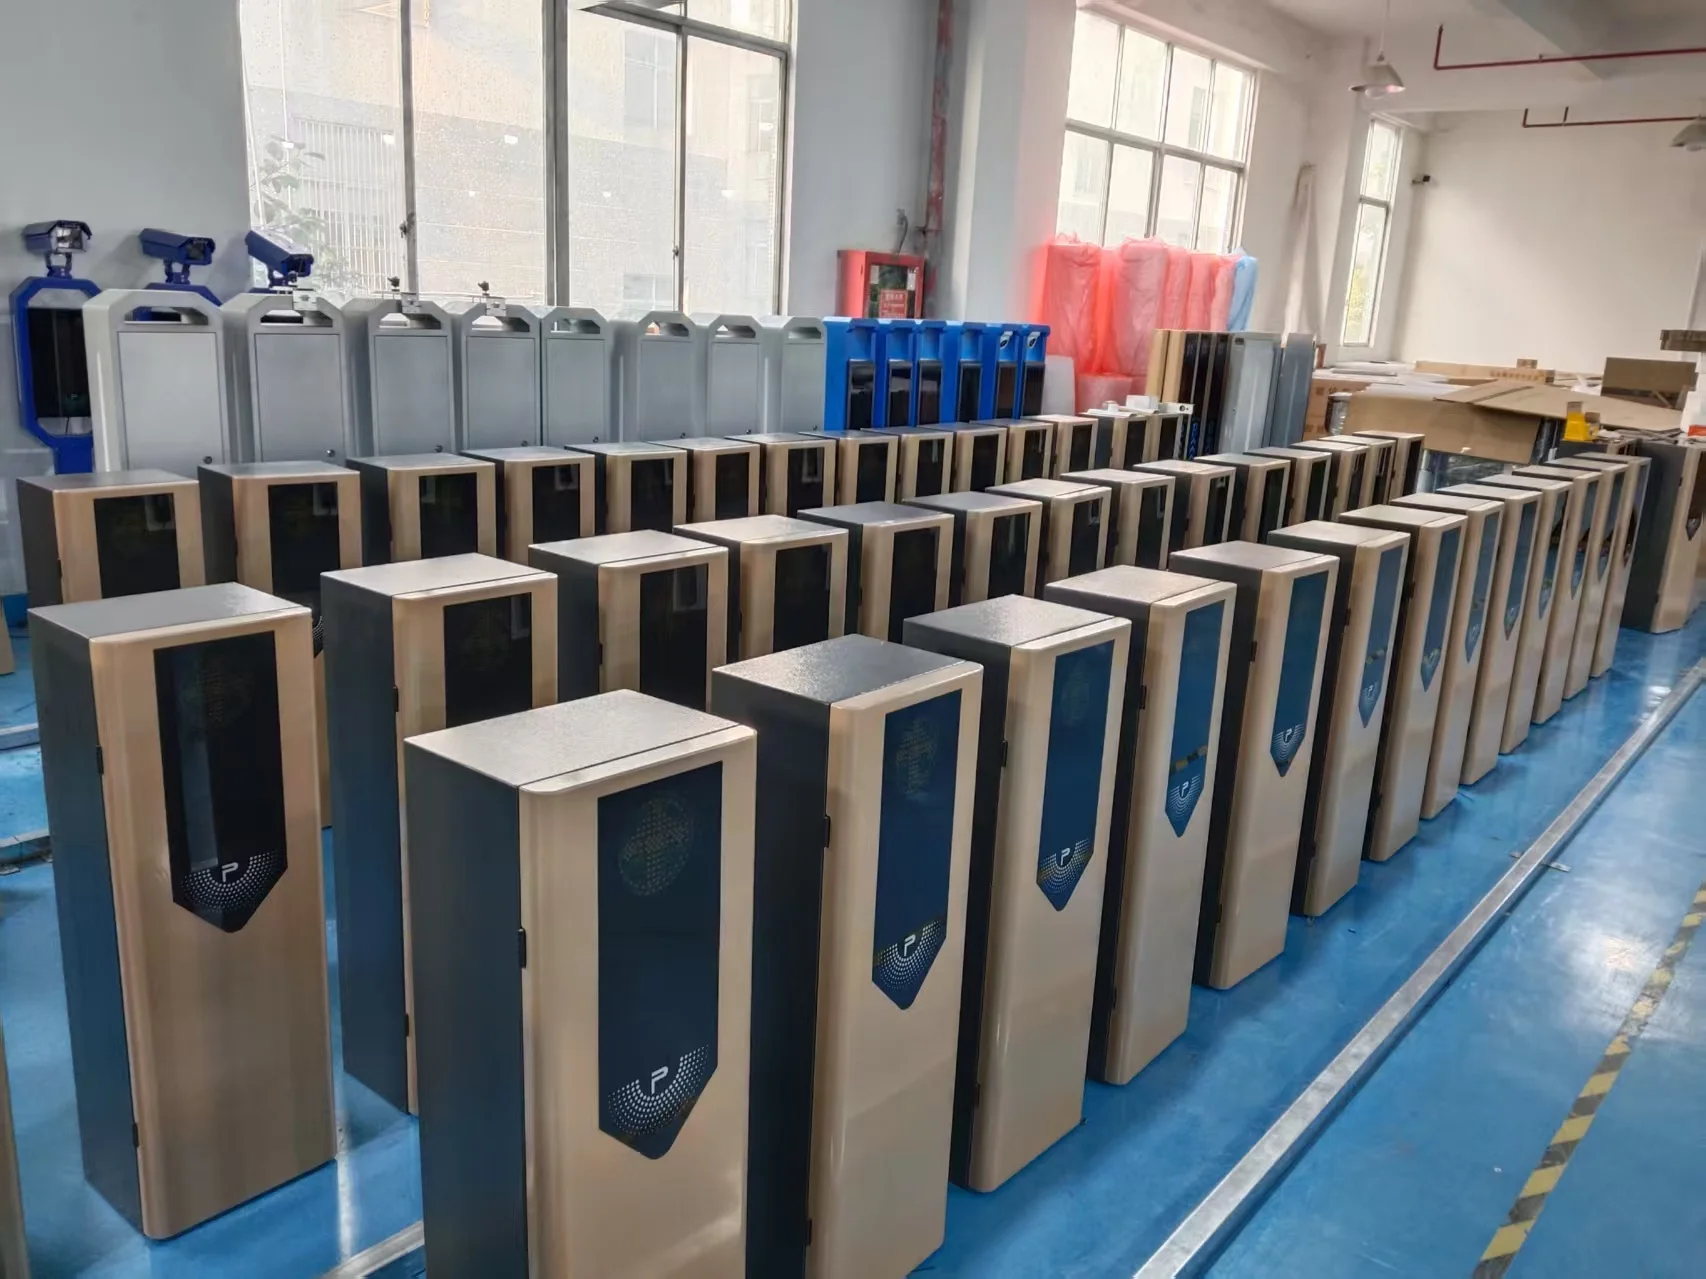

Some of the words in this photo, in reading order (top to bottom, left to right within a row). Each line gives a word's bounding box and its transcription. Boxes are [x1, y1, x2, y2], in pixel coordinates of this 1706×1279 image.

[1181, 780, 1189, 797] P
[1060, 847, 1071, 866] P
[221, 862, 239, 882] P
[904, 934, 916, 957] P
[651, 1066, 669, 1095] P
